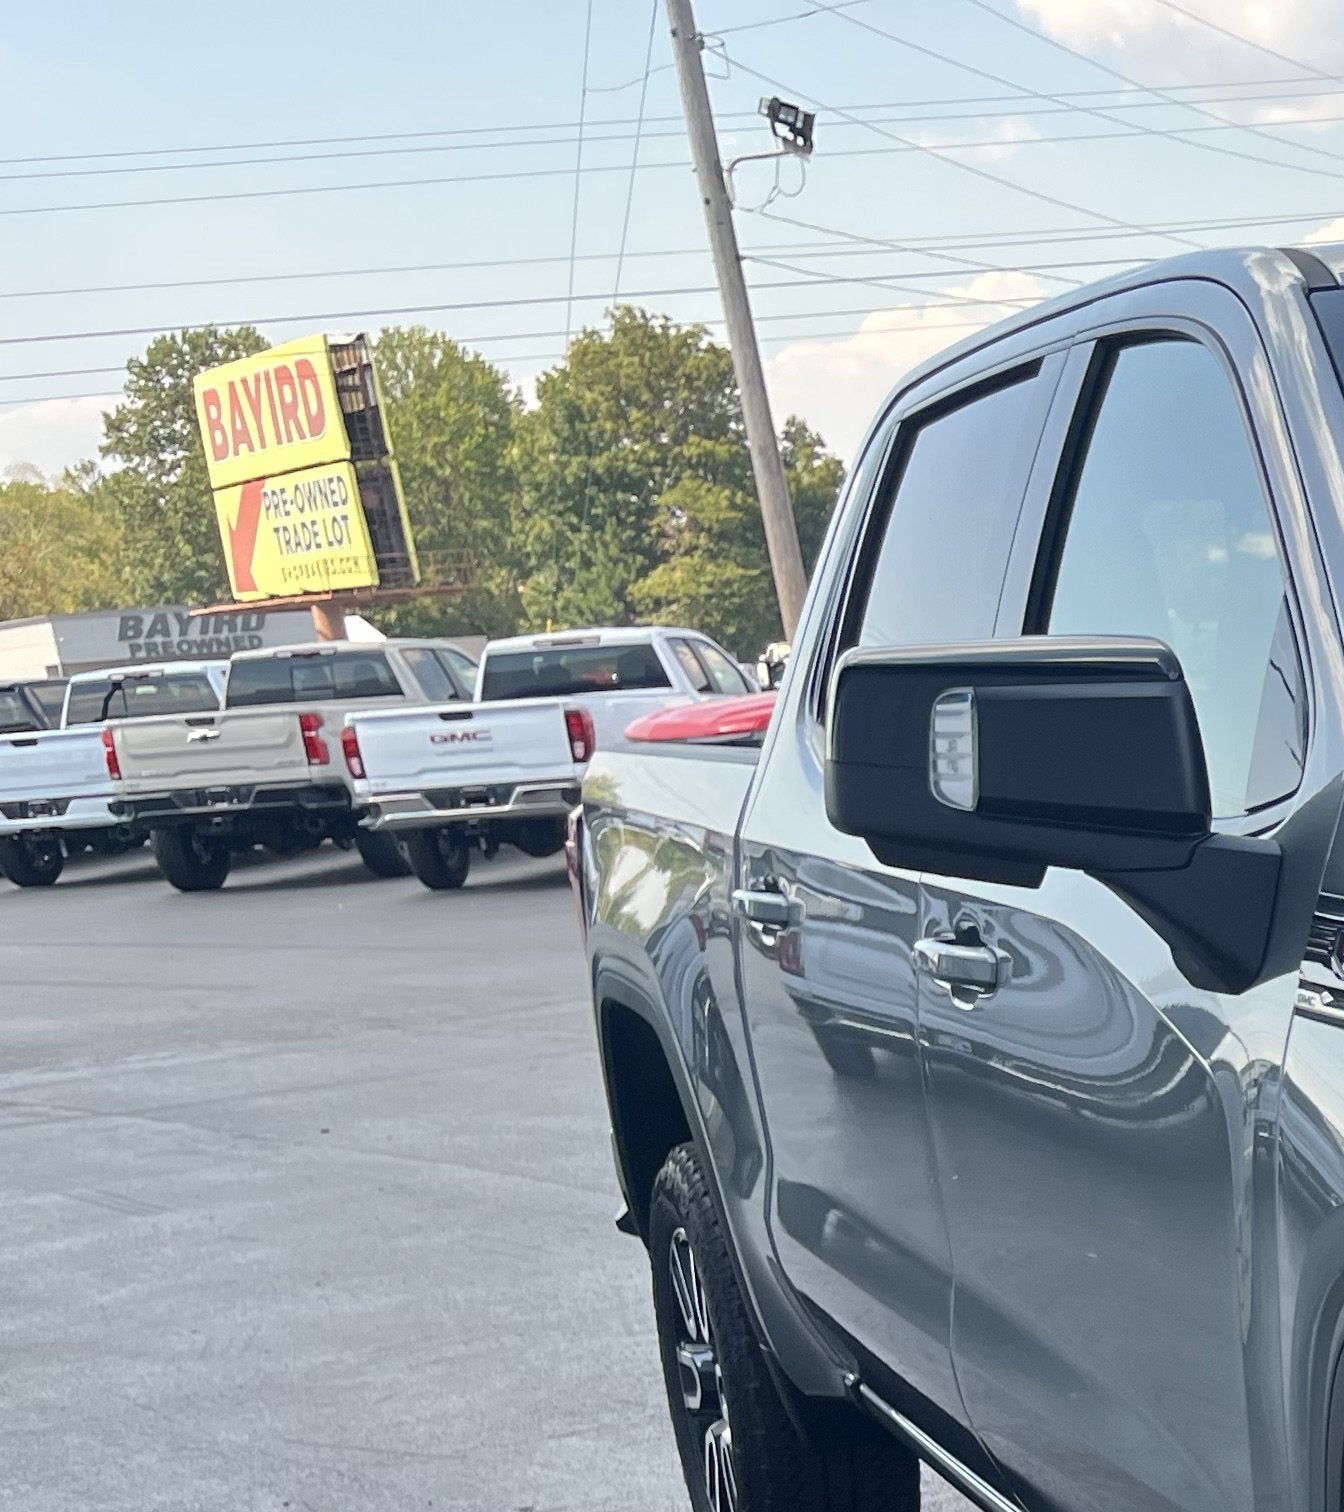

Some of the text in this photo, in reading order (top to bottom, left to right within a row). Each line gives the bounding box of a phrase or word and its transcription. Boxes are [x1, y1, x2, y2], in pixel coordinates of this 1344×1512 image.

[202, 358, 327, 462] BAYIRD
[262, 475, 349, 520] PRE-OWNED
[273, 514, 354, 556] TRADE LOT
[117, 611, 267, 642] BAYIRD
[128, 634, 264, 660] PREOWNED
[429, 729, 493, 746] GMC
